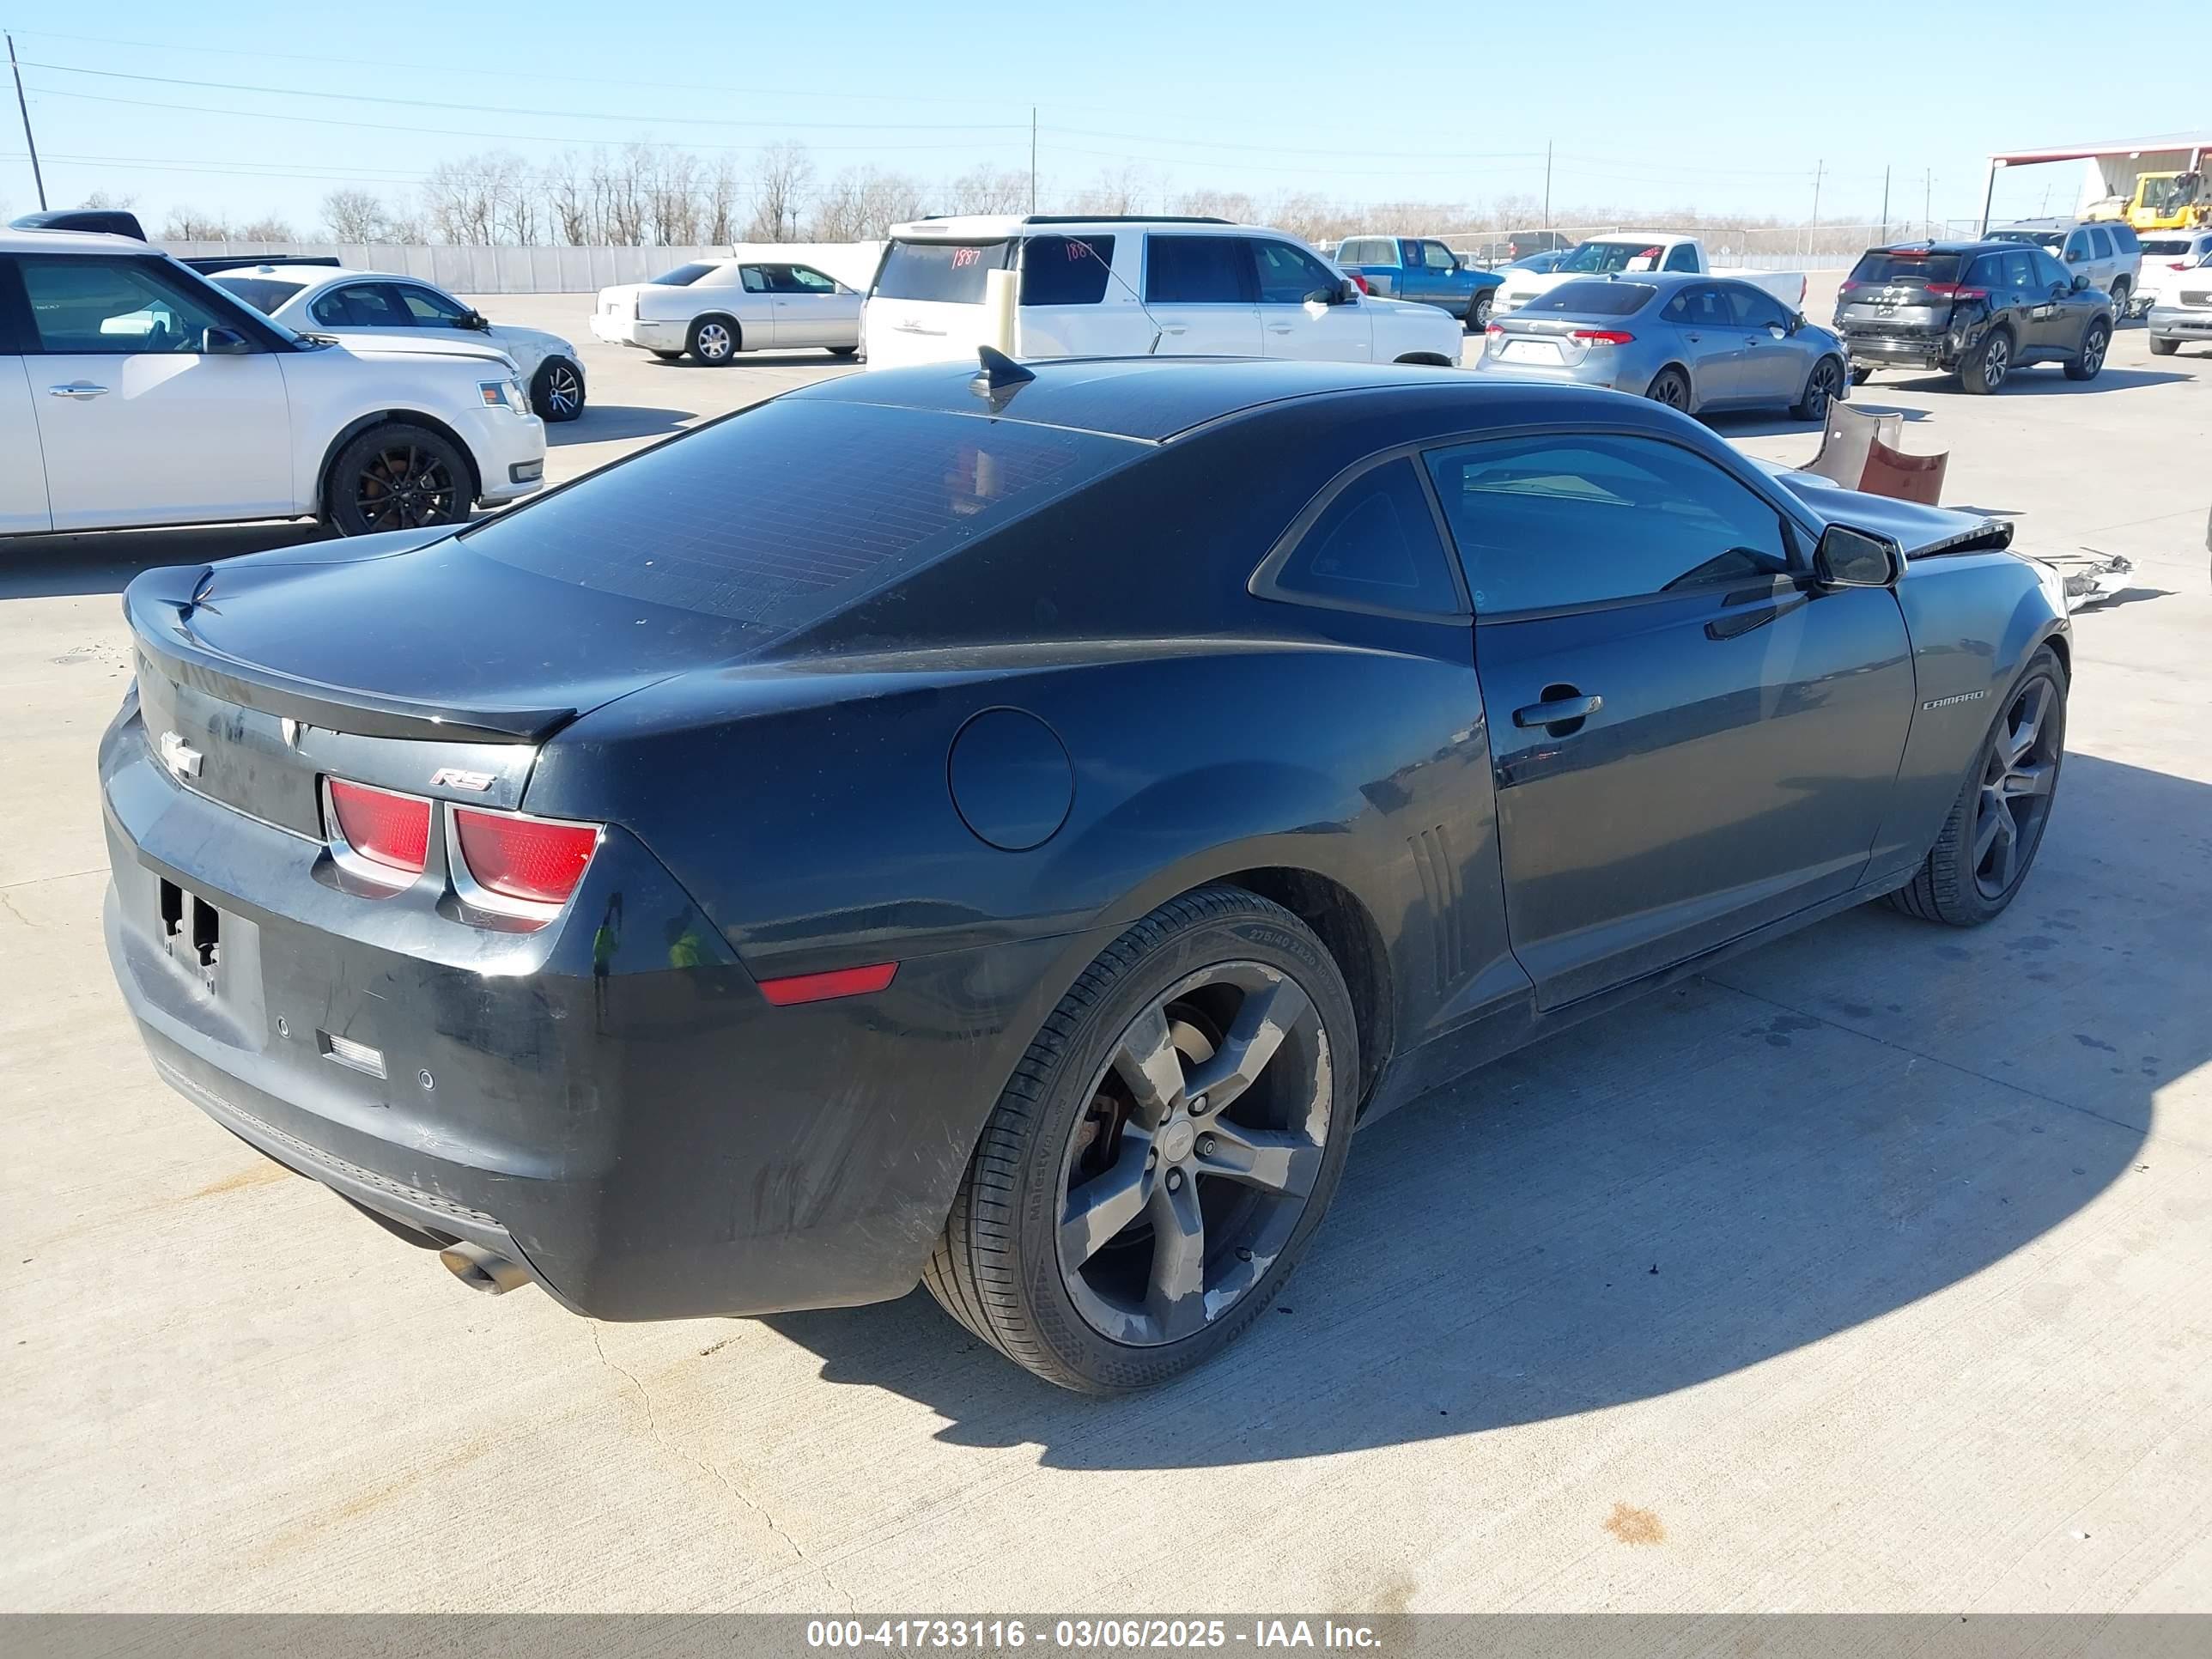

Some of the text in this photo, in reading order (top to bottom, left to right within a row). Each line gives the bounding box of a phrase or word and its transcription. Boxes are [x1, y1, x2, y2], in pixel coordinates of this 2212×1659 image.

[951, 249, 981, 270] 1887
[1922, 690, 1984, 711] CAMARO
[428, 767, 498, 792] RS
[1249, 928, 1290, 948] 275/40
